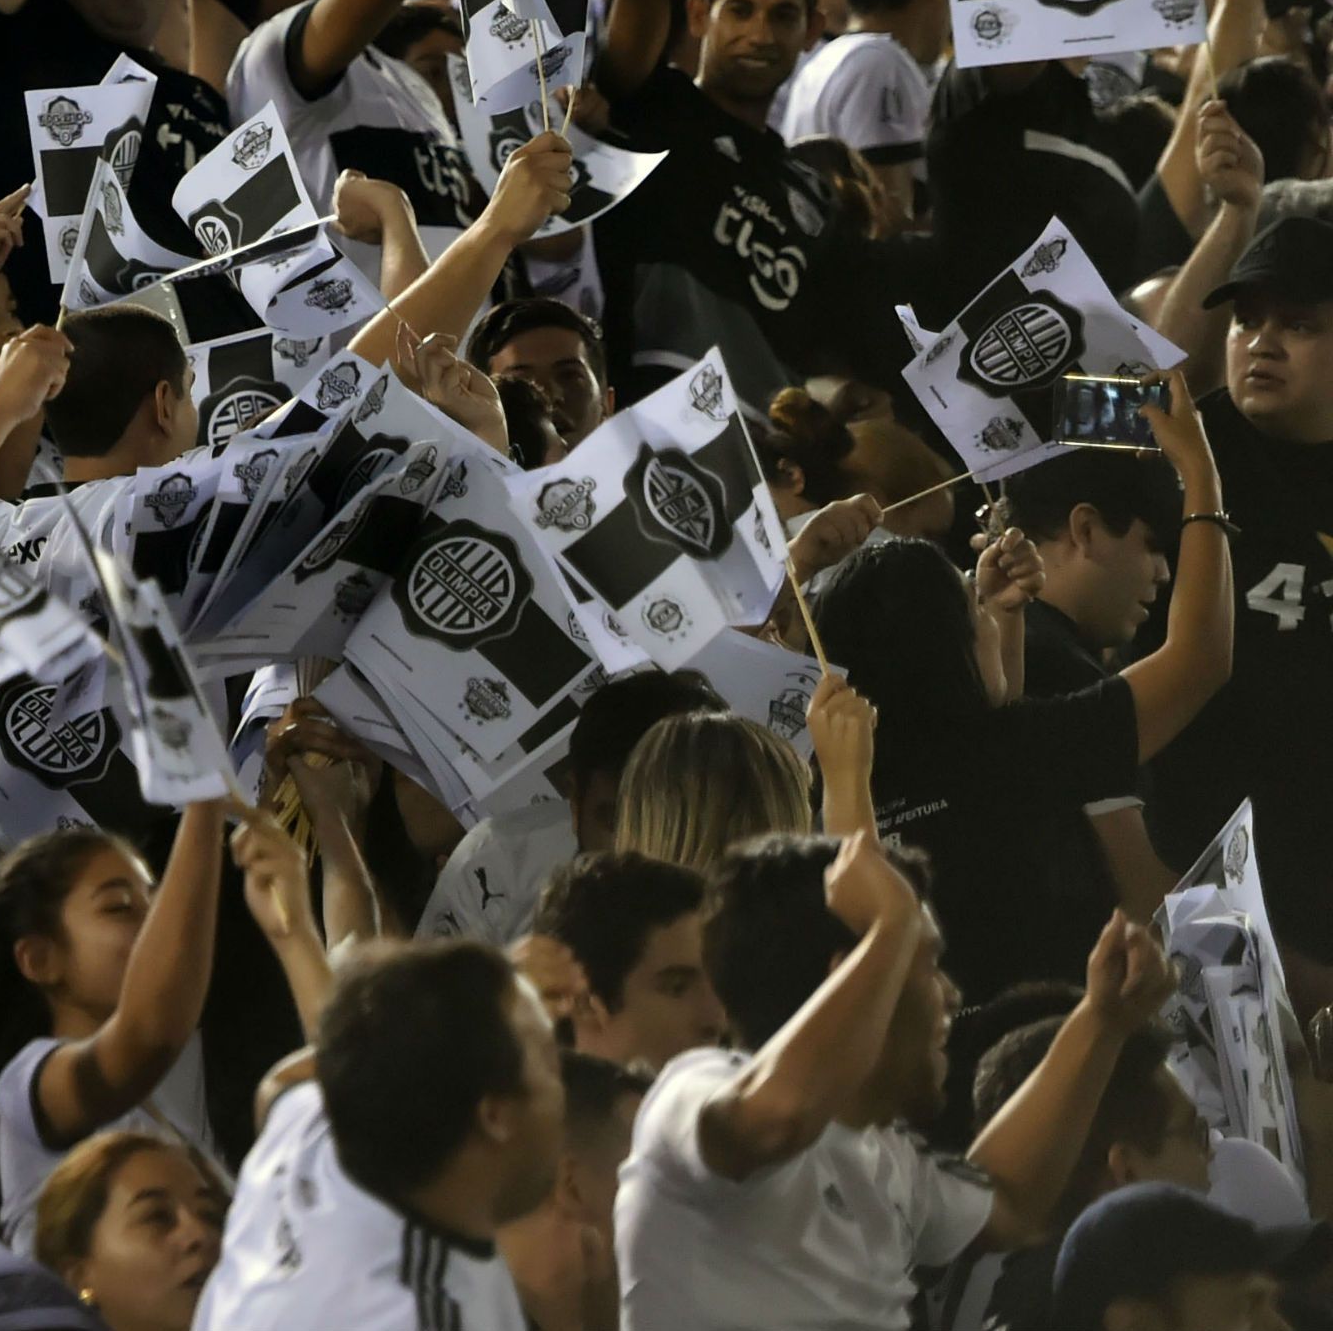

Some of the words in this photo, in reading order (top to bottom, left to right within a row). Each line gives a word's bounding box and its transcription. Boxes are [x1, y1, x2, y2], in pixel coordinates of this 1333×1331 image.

[716, 203, 807, 311] tigo
[997, 318, 1041, 373] OLIMPIA
[429, 557, 492, 615] OLIMPIA
